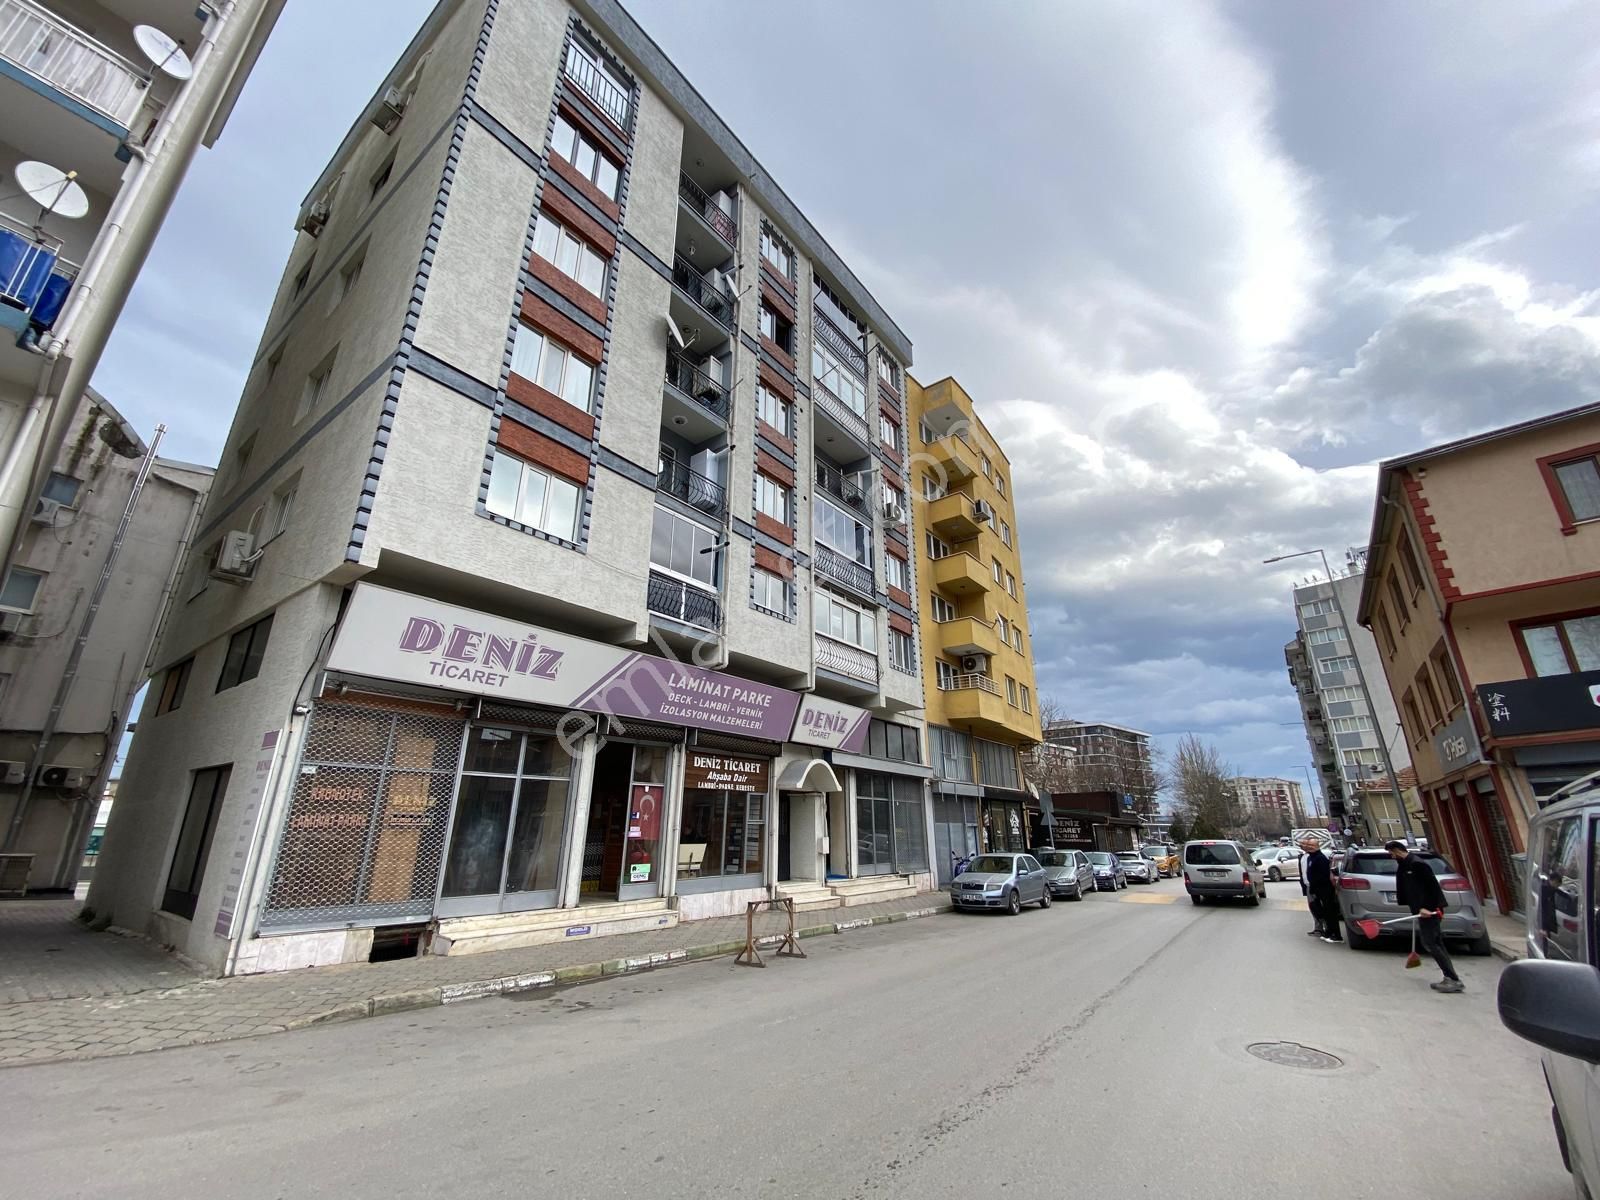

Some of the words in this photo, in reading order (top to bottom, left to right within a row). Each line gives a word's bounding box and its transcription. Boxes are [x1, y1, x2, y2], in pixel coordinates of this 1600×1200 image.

[399, 616, 565, 681] DENİZ
[429, 660, 509, 687] TİCARET
[668, 673, 732, 698] LAMİNAT
[732, 687, 773, 707] PARKE
[660, 702, 709, 721] İZOLASYON
[709, 714, 763, 730] MALZEMELERİ
[668, 693, 693, 705] DECK
[699, 699, 732, 712] LAMBRİ
[736, 706, 764, 718] VERNİK
[801, 709, 849, 734] DENİZ
[694, 755, 721, 769] DENİZ
[723, 758, 761, 773] TİCARET
[707, 771, 732, 782] Ahşaba
[733, 773, 748, 783] Dair
